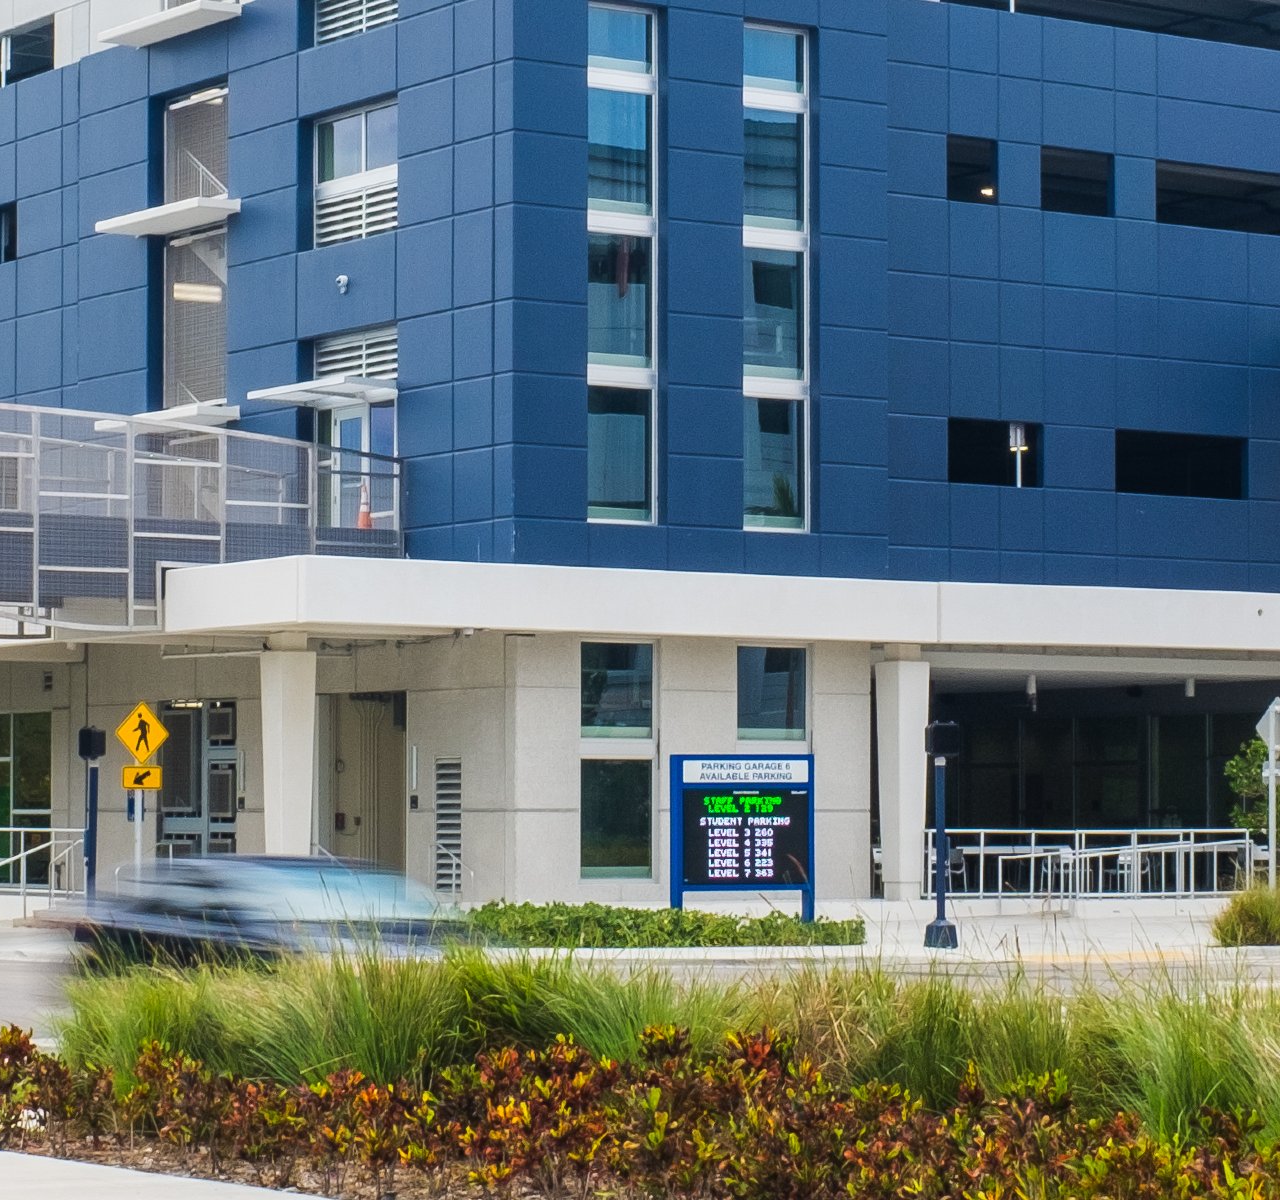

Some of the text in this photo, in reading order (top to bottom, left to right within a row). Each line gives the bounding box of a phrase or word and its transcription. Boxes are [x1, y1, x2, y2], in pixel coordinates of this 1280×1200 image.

[701, 762, 741, 770] PARKING
[744, 762, 783, 770] GARAGE
[700, 772, 792, 780] AVAILABLE PARKING
[703, 796, 782, 805] STAFF PARKING
[708, 804, 739, 813] LEVEL
[699, 816, 791, 826] STUDENT PARKING
[708, 828, 774, 837] LEVEL 3 260
[708, 838, 739, 847] LEVEL
[744, 838, 751, 847] 4
[708, 848, 774, 857] LEVEL 5 341
[708, 858, 774, 867] LEVEL 6 223
[708, 868, 739, 878] LEVEL
[744, 868, 751, 878] 7
